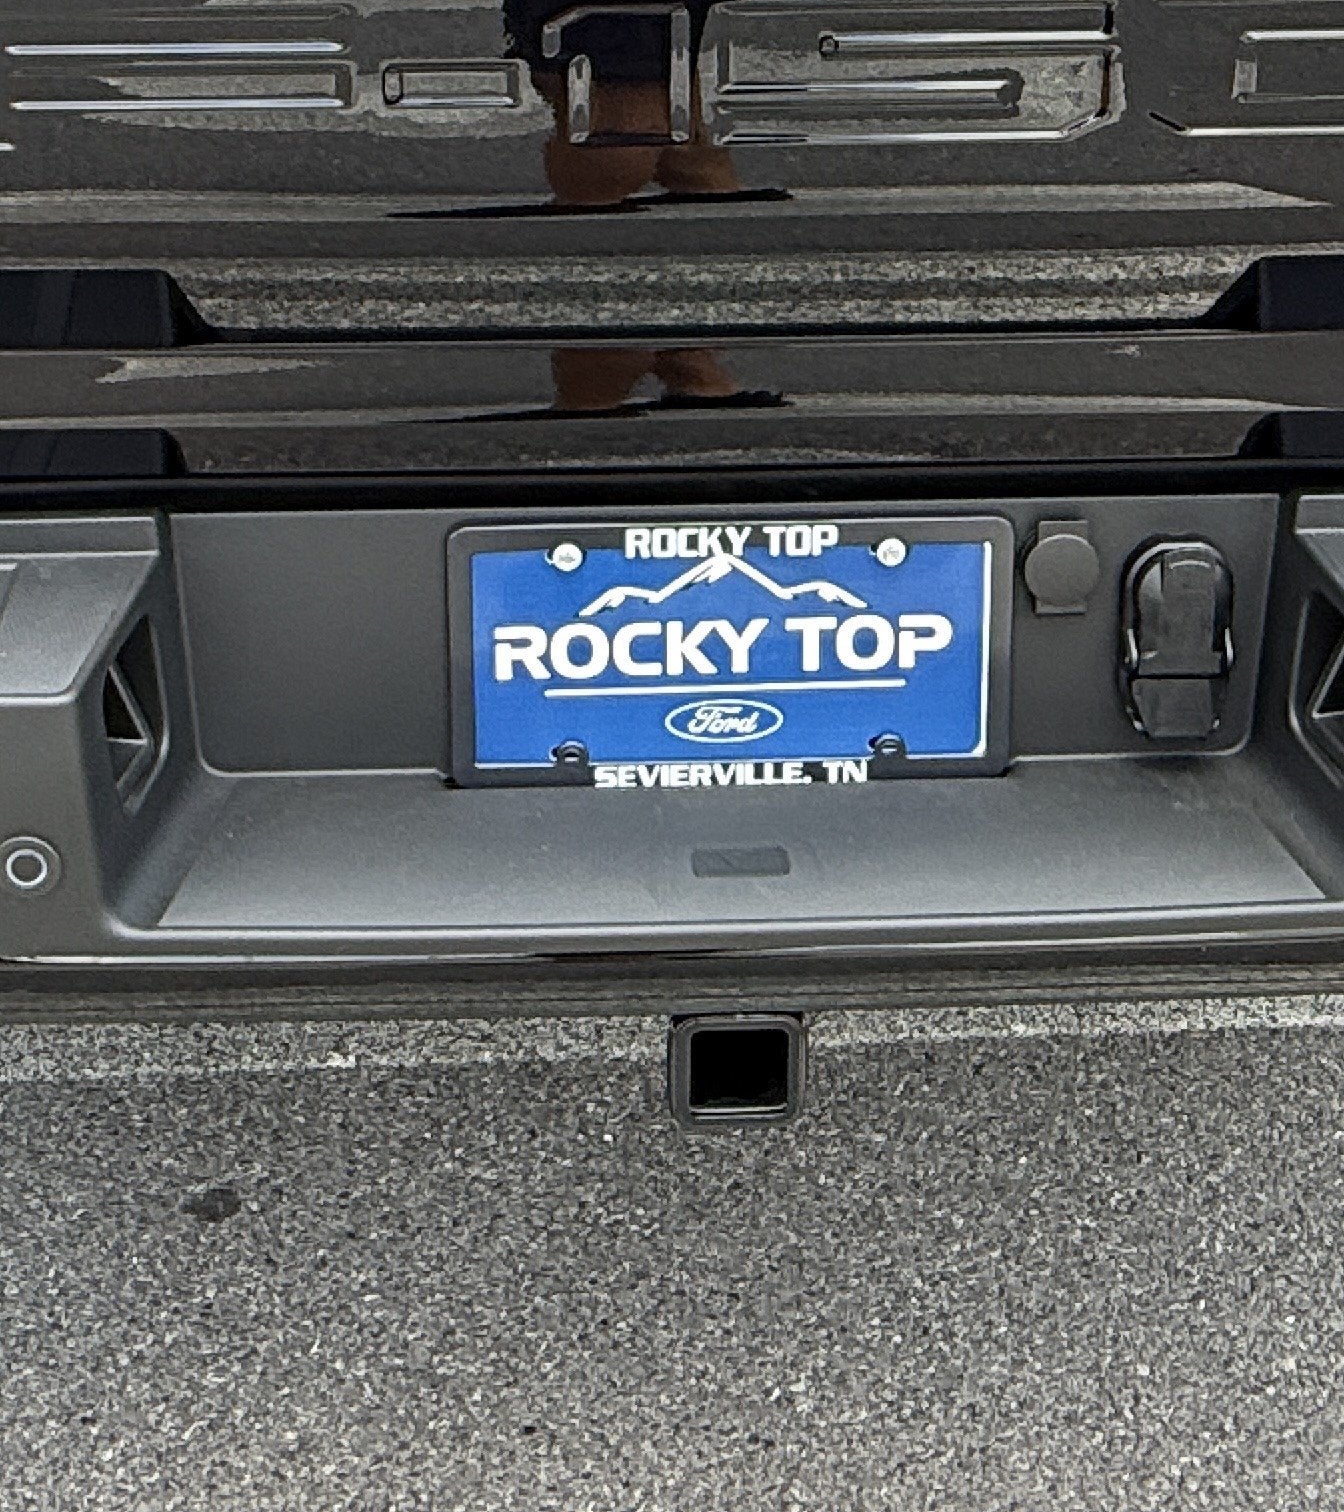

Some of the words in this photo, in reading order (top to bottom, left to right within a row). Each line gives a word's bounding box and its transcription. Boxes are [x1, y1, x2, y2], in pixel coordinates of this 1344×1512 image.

[624, 526, 752, 560] ROCKY
[763, 524, 839, 558] TOP
[493, 618, 770, 681] ROCKY
[785, 614, 954, 672] TOP
[687, 706, 760, 734] Ford
[822, 760, 868, 784] TN
